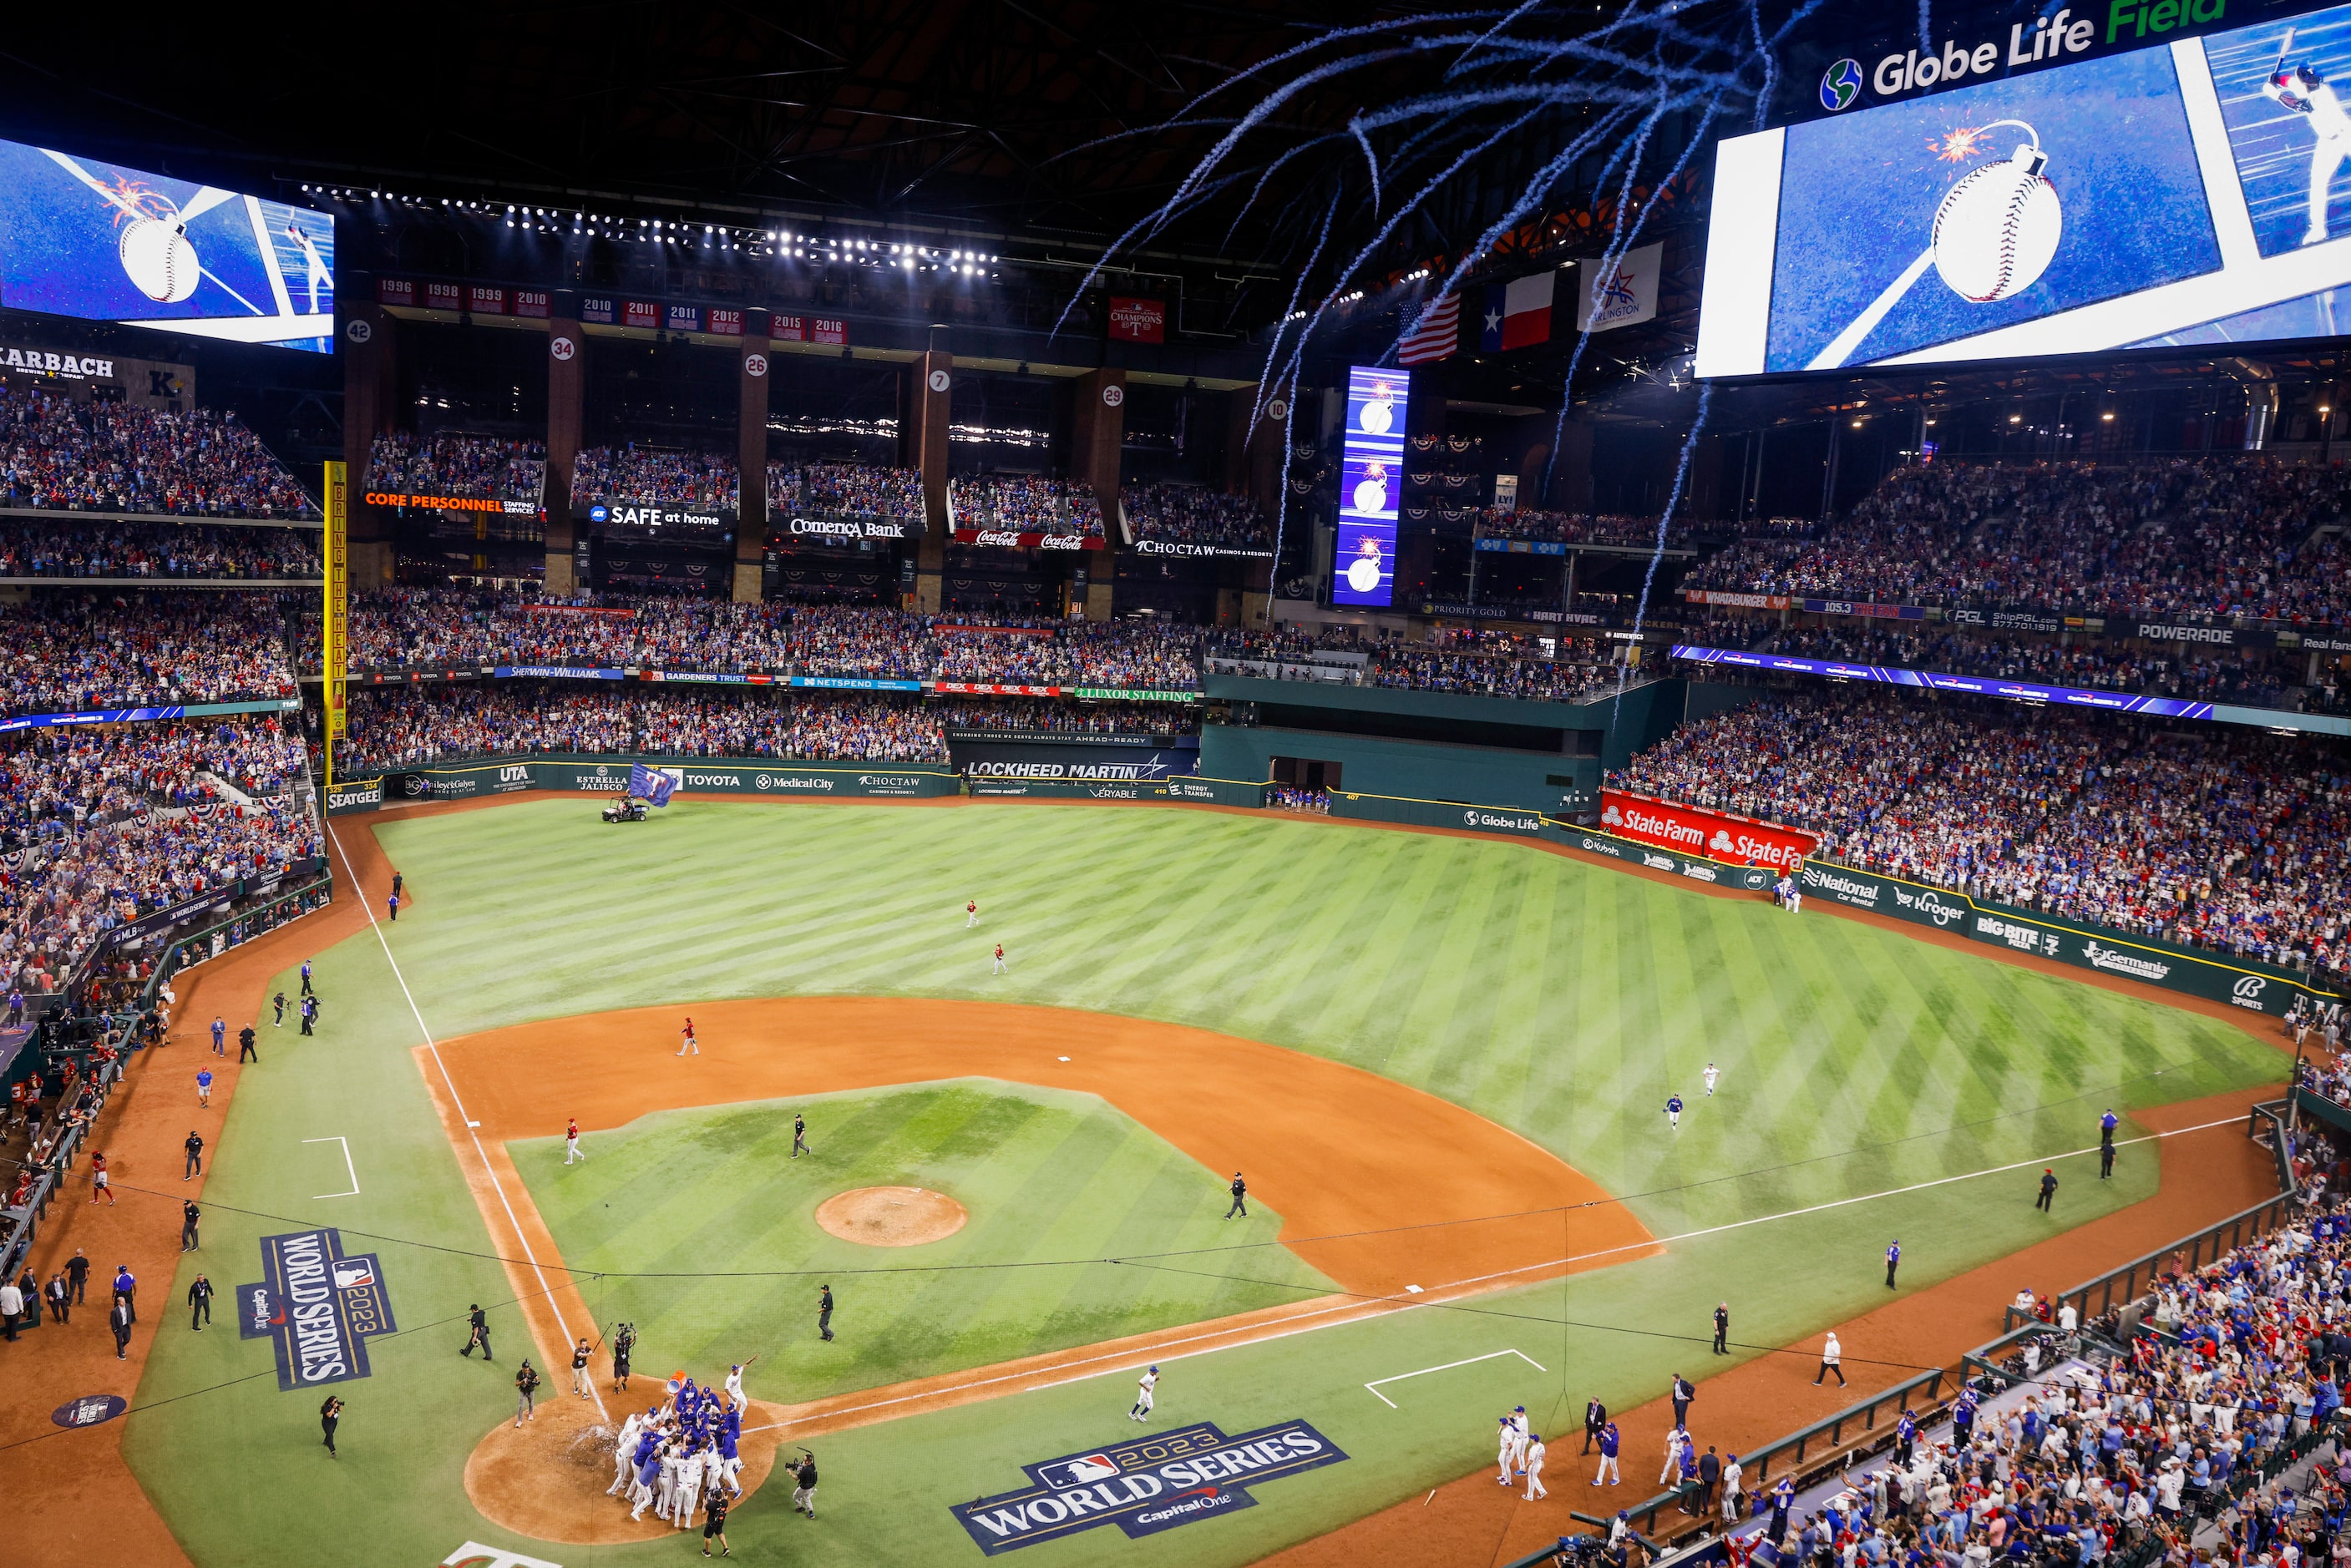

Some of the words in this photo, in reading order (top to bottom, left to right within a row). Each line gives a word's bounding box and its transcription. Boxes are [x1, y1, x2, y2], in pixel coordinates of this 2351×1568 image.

[1872, 39, 1996, 95] Globe
[2007, 9, 2095, 68] Life
[2105, 0, 2227, 44] Field
[383, 280, 412, 292] 1996
[428, 283, 459, 297] 1998
[473, 288, 502, 301] 1999
[518, 292, 546, 305] 2010
[585, 299, 611, 311] 2010
[629, 302, 654, 315] 2011
[671, 306, 696, 319] 2011
[713, 311, 739, 323] 2012
[1111, 312, 1162, 324] CHAMPIONS
[775, 316, 801, 328] 2015
[816, 320, 842, 332] 2016
[350, 324, 367, 338] 42
[554, 342, 572, 356] 34
[16, 367, 45, 376] BREWING
[748, 360, 764, 372] 26
[935, 374, 945, 387] 7
[1106, 390, 1121, 402] 29
[1273, 404, 1283, 416] 10
[366, 492, 407, 506] CORE
[412, 495, 503, 512] PERSONNEL
[504, 501, 535, 509] STAFFING
[611, 508, 662, 526] SAFE
[665, 512, 680, 523] at
[683, 513, 720, 525] home
[865, 522, 904, 539] Bank
[976, 529, 1021, 547] Coca-Cola
[1041, 534, 1084, 550] Coca-Cola
[1144, 540, 1214, 556] CHOCTAW
[1706, 591, 1766, 607] WHATABURGER
[1435, 605, 1477, 615] PRIORITY
[1479, 608, 1507, 617] GOLD
[1825, 601, 1851, 614] 105.3
[1854, 604, 1874, 615] THE
[1877, 605, 1899, 617] FAN
[1533, 611, 1564, 622] HART
[1566, 613, 1598, 625] HVAC
[1954, 610, 1985, 623] PGL
[1993, 613, 2058, 624] ShipPGL.com
[1993, 620, 2057, 632] 877.701.1919
[1613, 632, 1644, 640] AUTHENTICS
[2139, 625, 2232, 644] POWERADE
[2304, 638, 2329, 649] Real
[666, 672, 717, 681] GARDENERS
[719, 675, 746, 683] TRUST
[818, 678, 872, 688] NETSPEND
[1087, 688, 1129, 699] LUXOR
[1132, 690, 1193, 702] STAFFING
[501, 766, 528, 781] UTA
[968, 761, 1064, 777] LOCKHEED
[1068, 764, 1138, 779] MARTIN
[687, 775, 740, 787] TOYOTA
[773, 777, 812, 789] Medical
[813, 778, 833, 791] City
[864, 775, 920, 787] CHOCTAW
[1481, 814, 1515, 828] Globe
[1517, 817, 1539, 831] Life
[1594, 842, 1619, 856] Kubota
[1652, 856, 1671, 867] ARROW
[1691, 865, 1711, 877] ARROW
[1748, 876, 1763, 884] ADT
[1837, 893, 1849, 902] Car
[1851, 896, 1874, 908] Rental
[176, 905, 192, 918] WORLD
[192, 899, 209, 912] SERIES
[1914, 892, 1964, 926] Kroger
[121, 928, 137, 941] MLB
[137, 925, 146, 935] App
[2004, 923, 2039, 945] BITE
[2106, 949, 2170, 974] Germania
[2108, 962, 2156, 979] INSURANCE
[2232, 996, 2263, 1011] SPORTS
[283, 1233, 330, 1304] WORLD
[347, 1287, 377, 1333] 2023
[293, 1303, 346, 1382] SERIES
[1116, 1433, 1219, 1467] 2023
[682, 1466, 688, 1474] 4
[970, 1474, 1163, 1538] WORLD
[1160, 1431, 1322, 1489] SERIES
